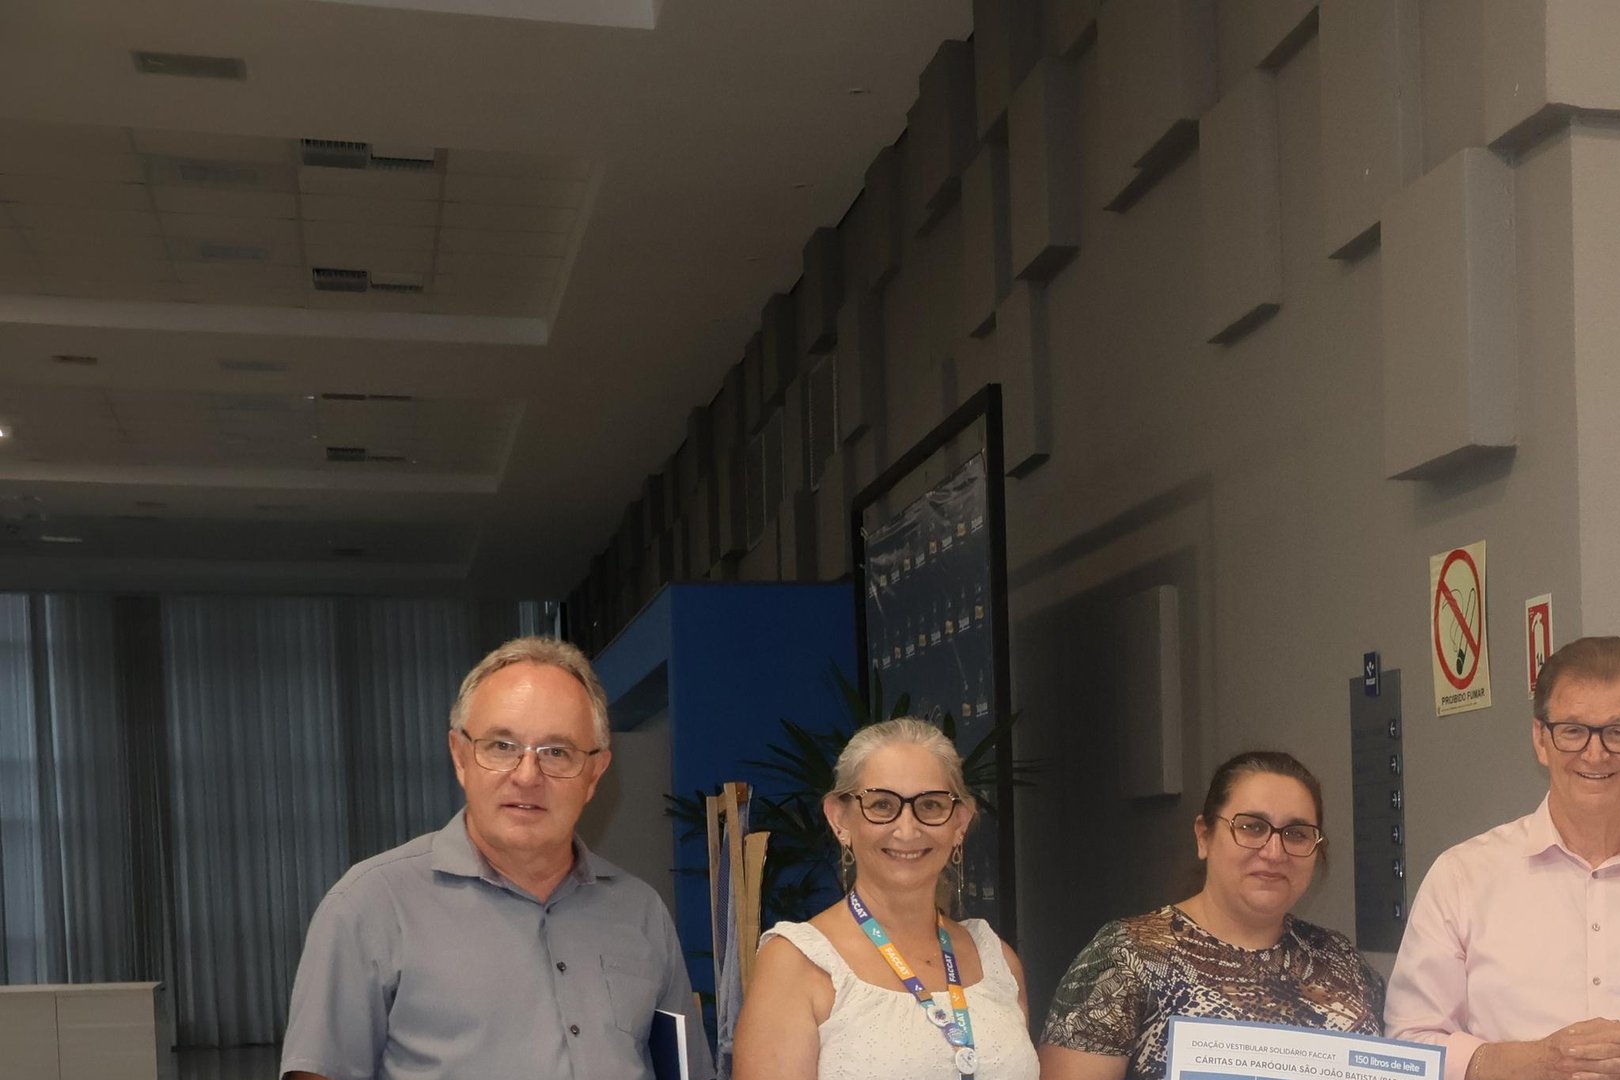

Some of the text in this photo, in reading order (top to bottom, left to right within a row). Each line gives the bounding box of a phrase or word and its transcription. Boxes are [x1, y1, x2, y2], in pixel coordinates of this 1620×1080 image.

[1442, 688, 1485, 705] PROIBIDO FUMAR
[885, 947, 910, 975] FACCAT
[945, 954, 956, 982] FACCAT
[1191, 1040, 1336, 1061] DOAÇÃO VESTIBULAR SOLIDÁRIO FACCAT
[1195, 1055, 1233, 1066] CÁRITAS
[1235, 1059, 1248, 1067] DA
[1250, 1060, 1297, 1072] PARÓQUIA
[1299, 1064, 1317, 1075] SÃO
[1320, 1067, 1343, 1078] JOÃO
[1354, 1055, 1420, 1072] 150 litros de leite
